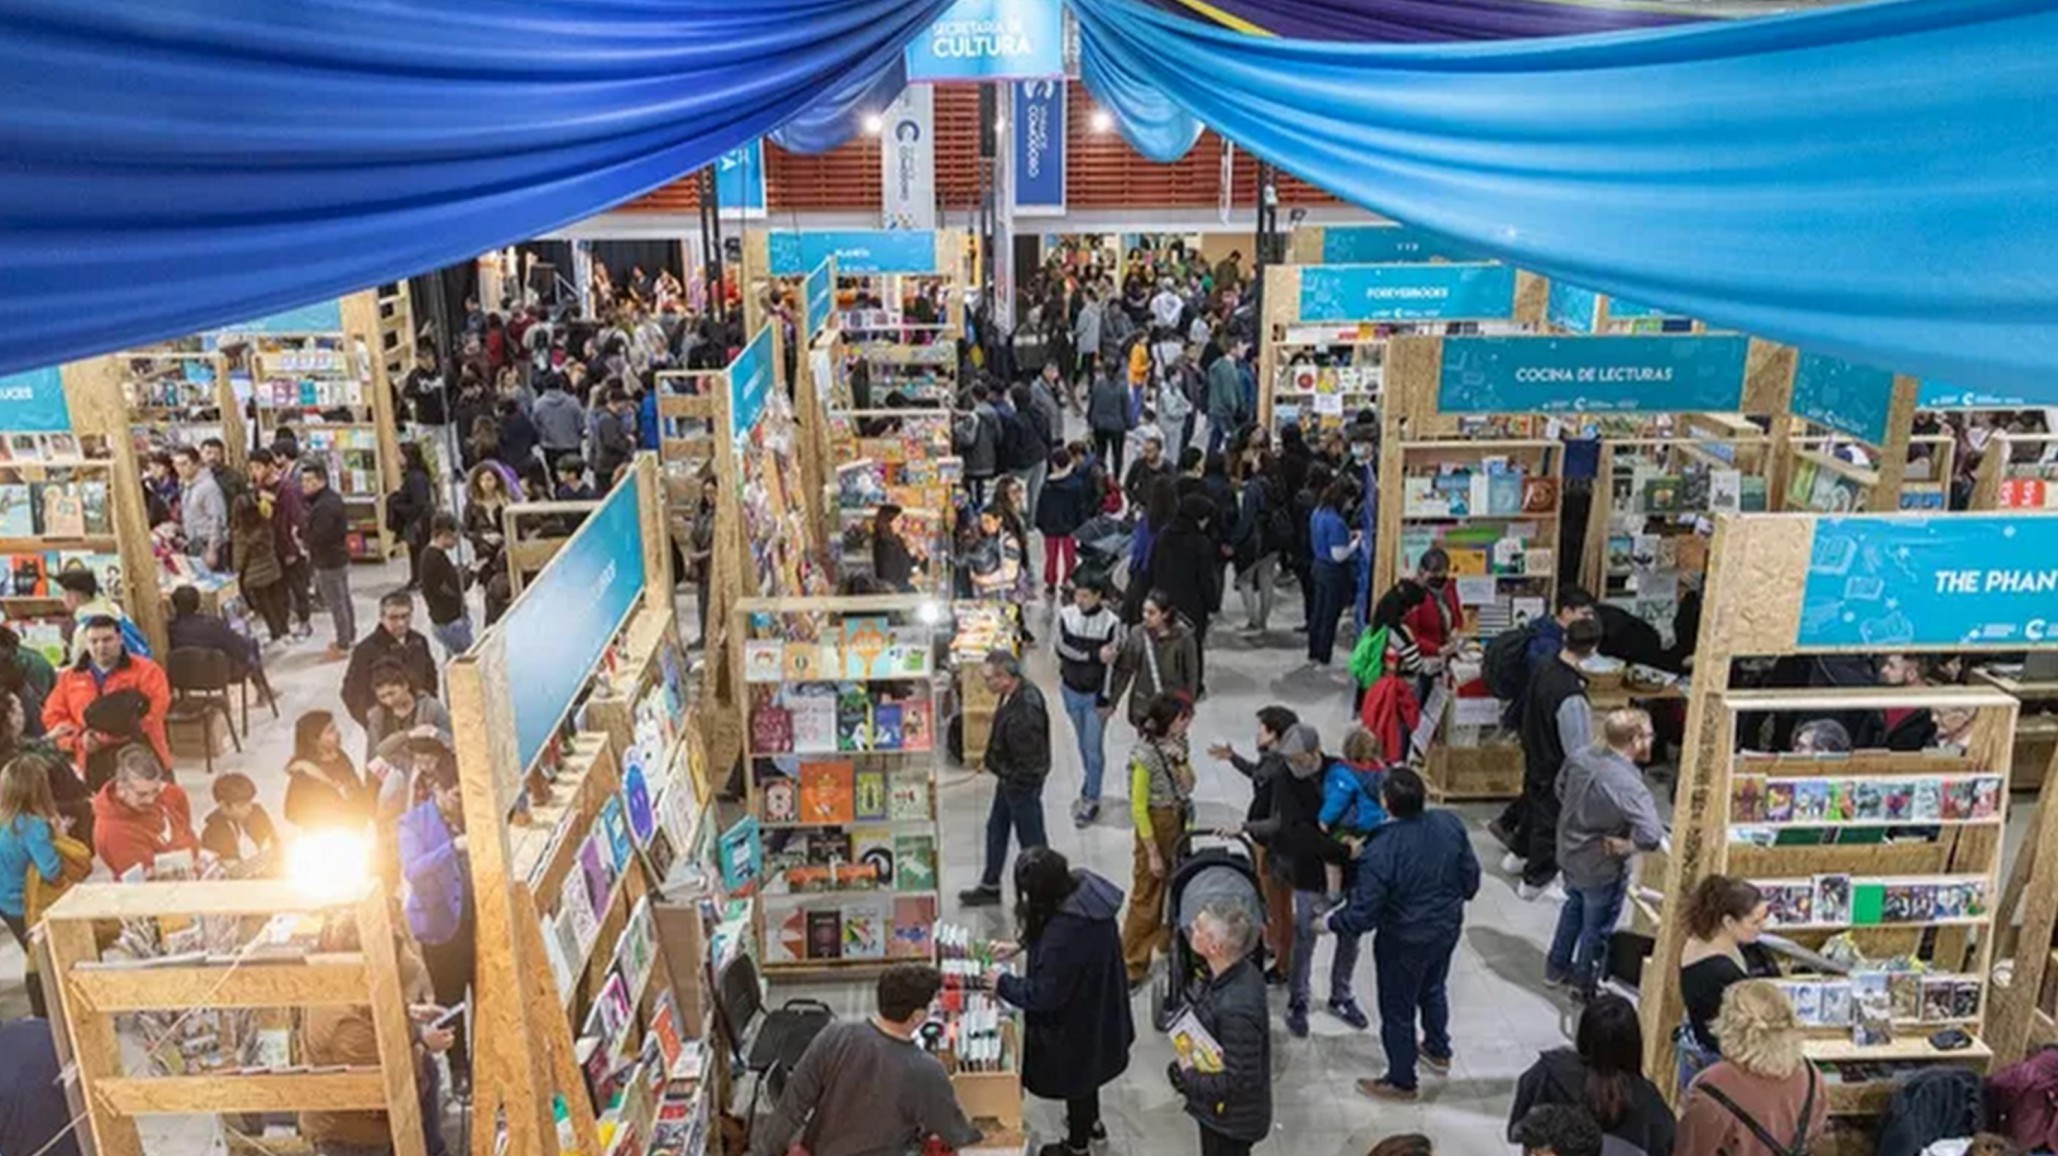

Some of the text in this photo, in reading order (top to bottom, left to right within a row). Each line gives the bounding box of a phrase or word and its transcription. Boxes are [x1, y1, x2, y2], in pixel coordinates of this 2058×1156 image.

[933, 37, 1030, 57] CULTURA
[1515, 365, 1674, 382] COCINA DE LECTURAS
[1934, 569, 1982, 593] THE
